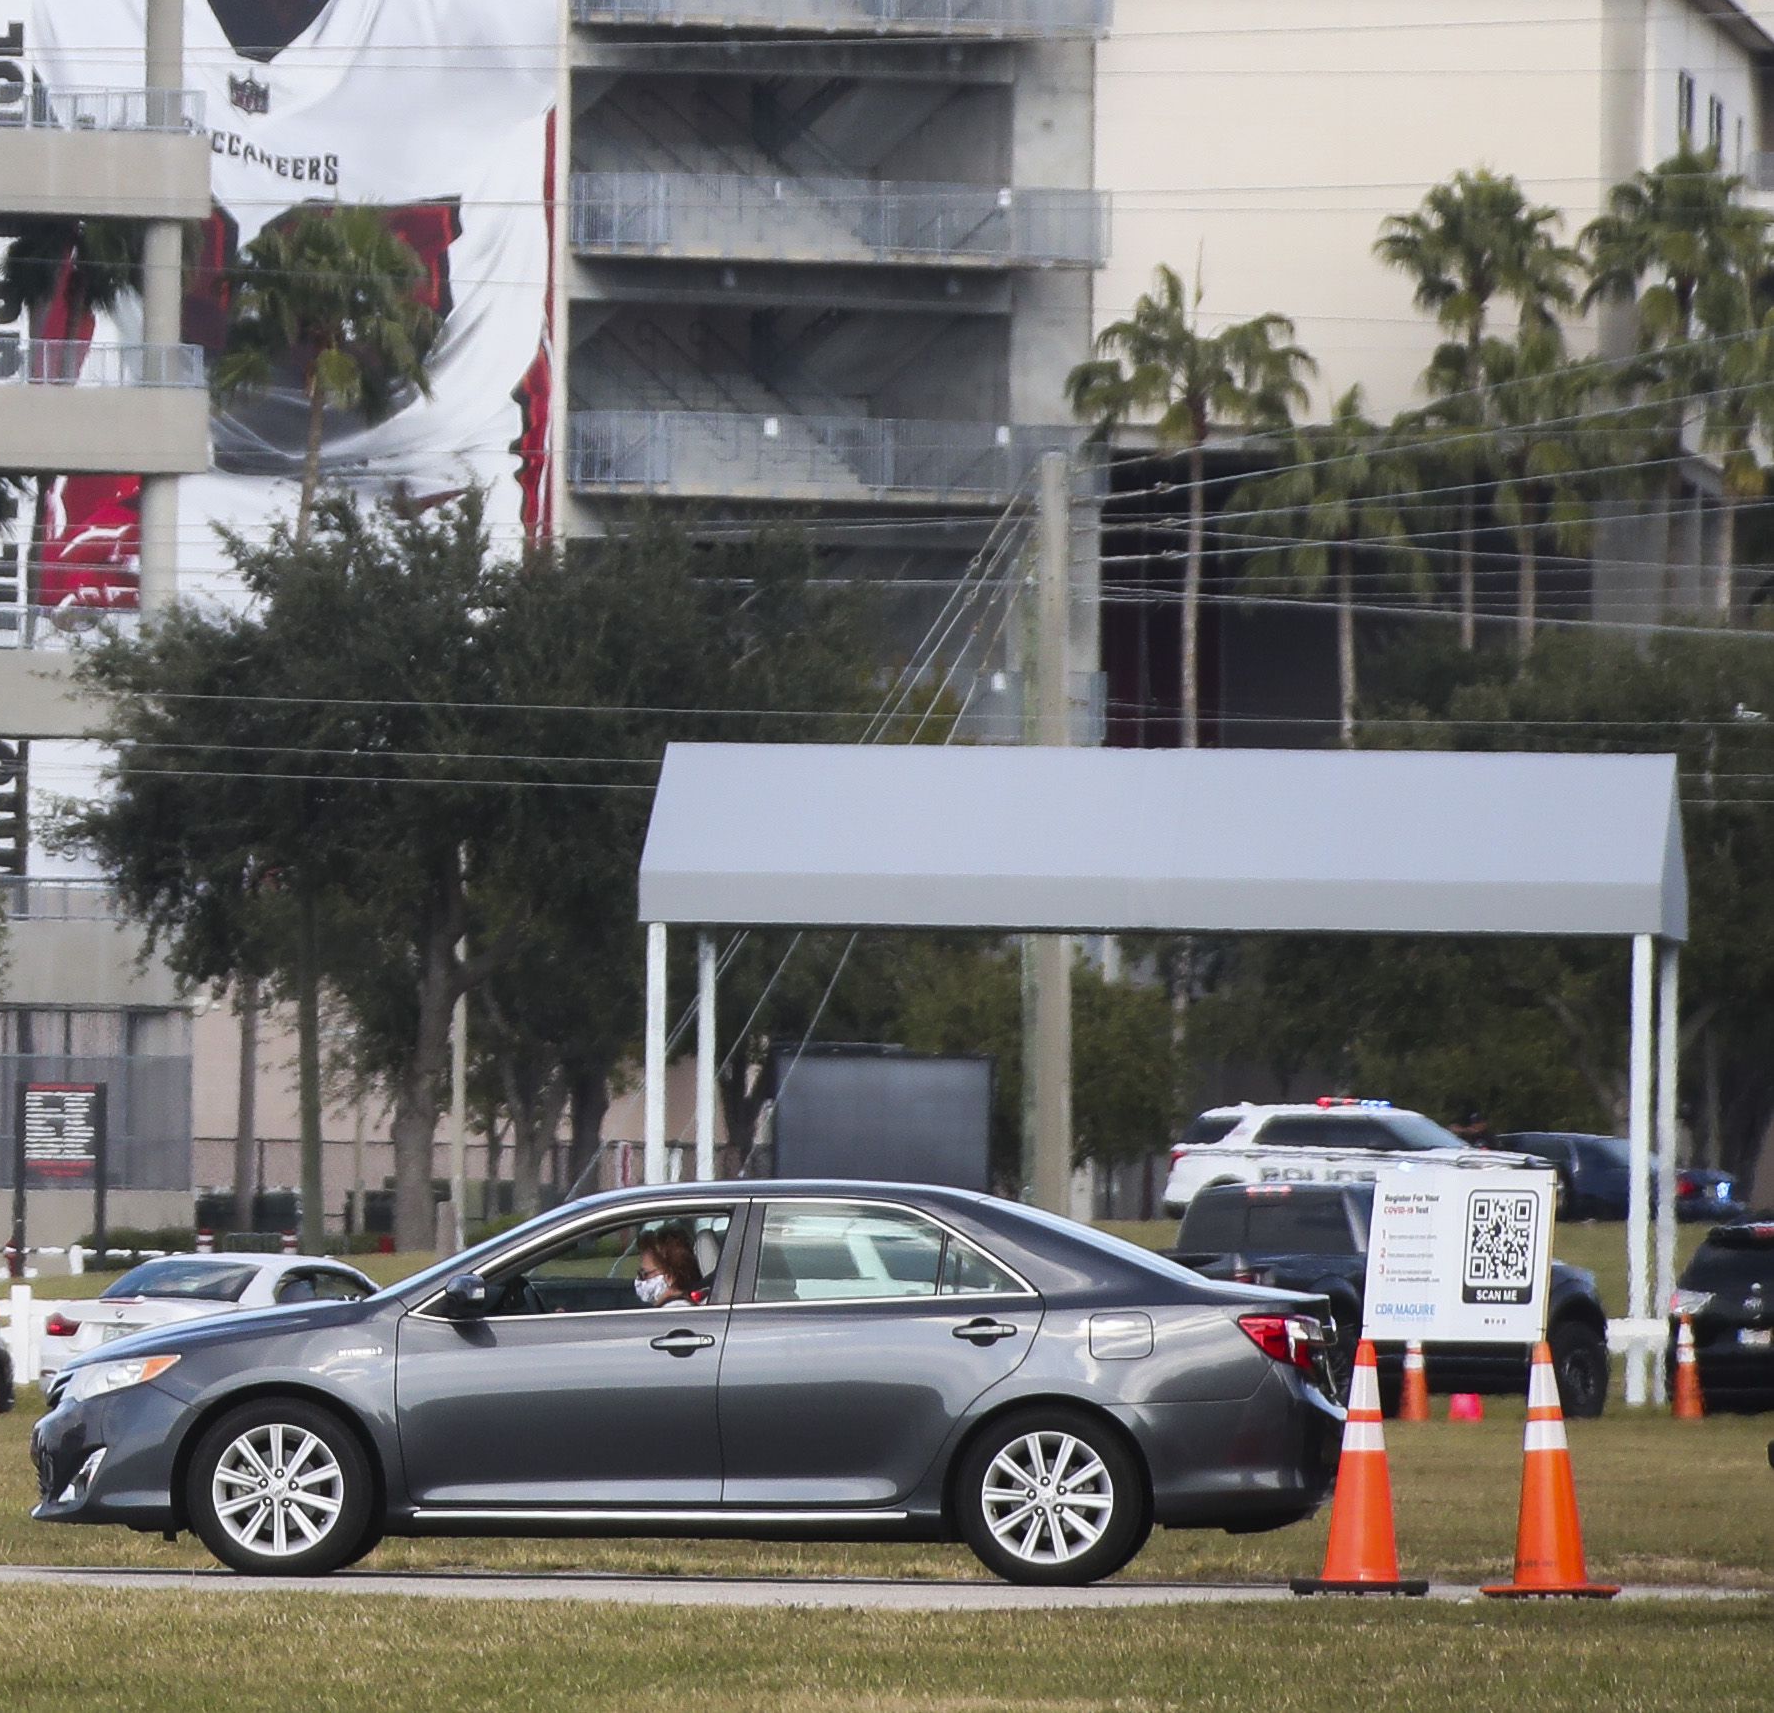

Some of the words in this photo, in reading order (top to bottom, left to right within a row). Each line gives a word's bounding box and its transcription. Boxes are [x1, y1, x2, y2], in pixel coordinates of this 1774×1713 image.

[211, 128, 339, 186] CCANEERS
[1476, 1289, 1501, 1301] SCAN
[1503, 1289, 1518, 1301] ME
[1375, 1303, 1393, 1315] CDR
[1395, 1303, 1437, 1316] MAGUIRE
